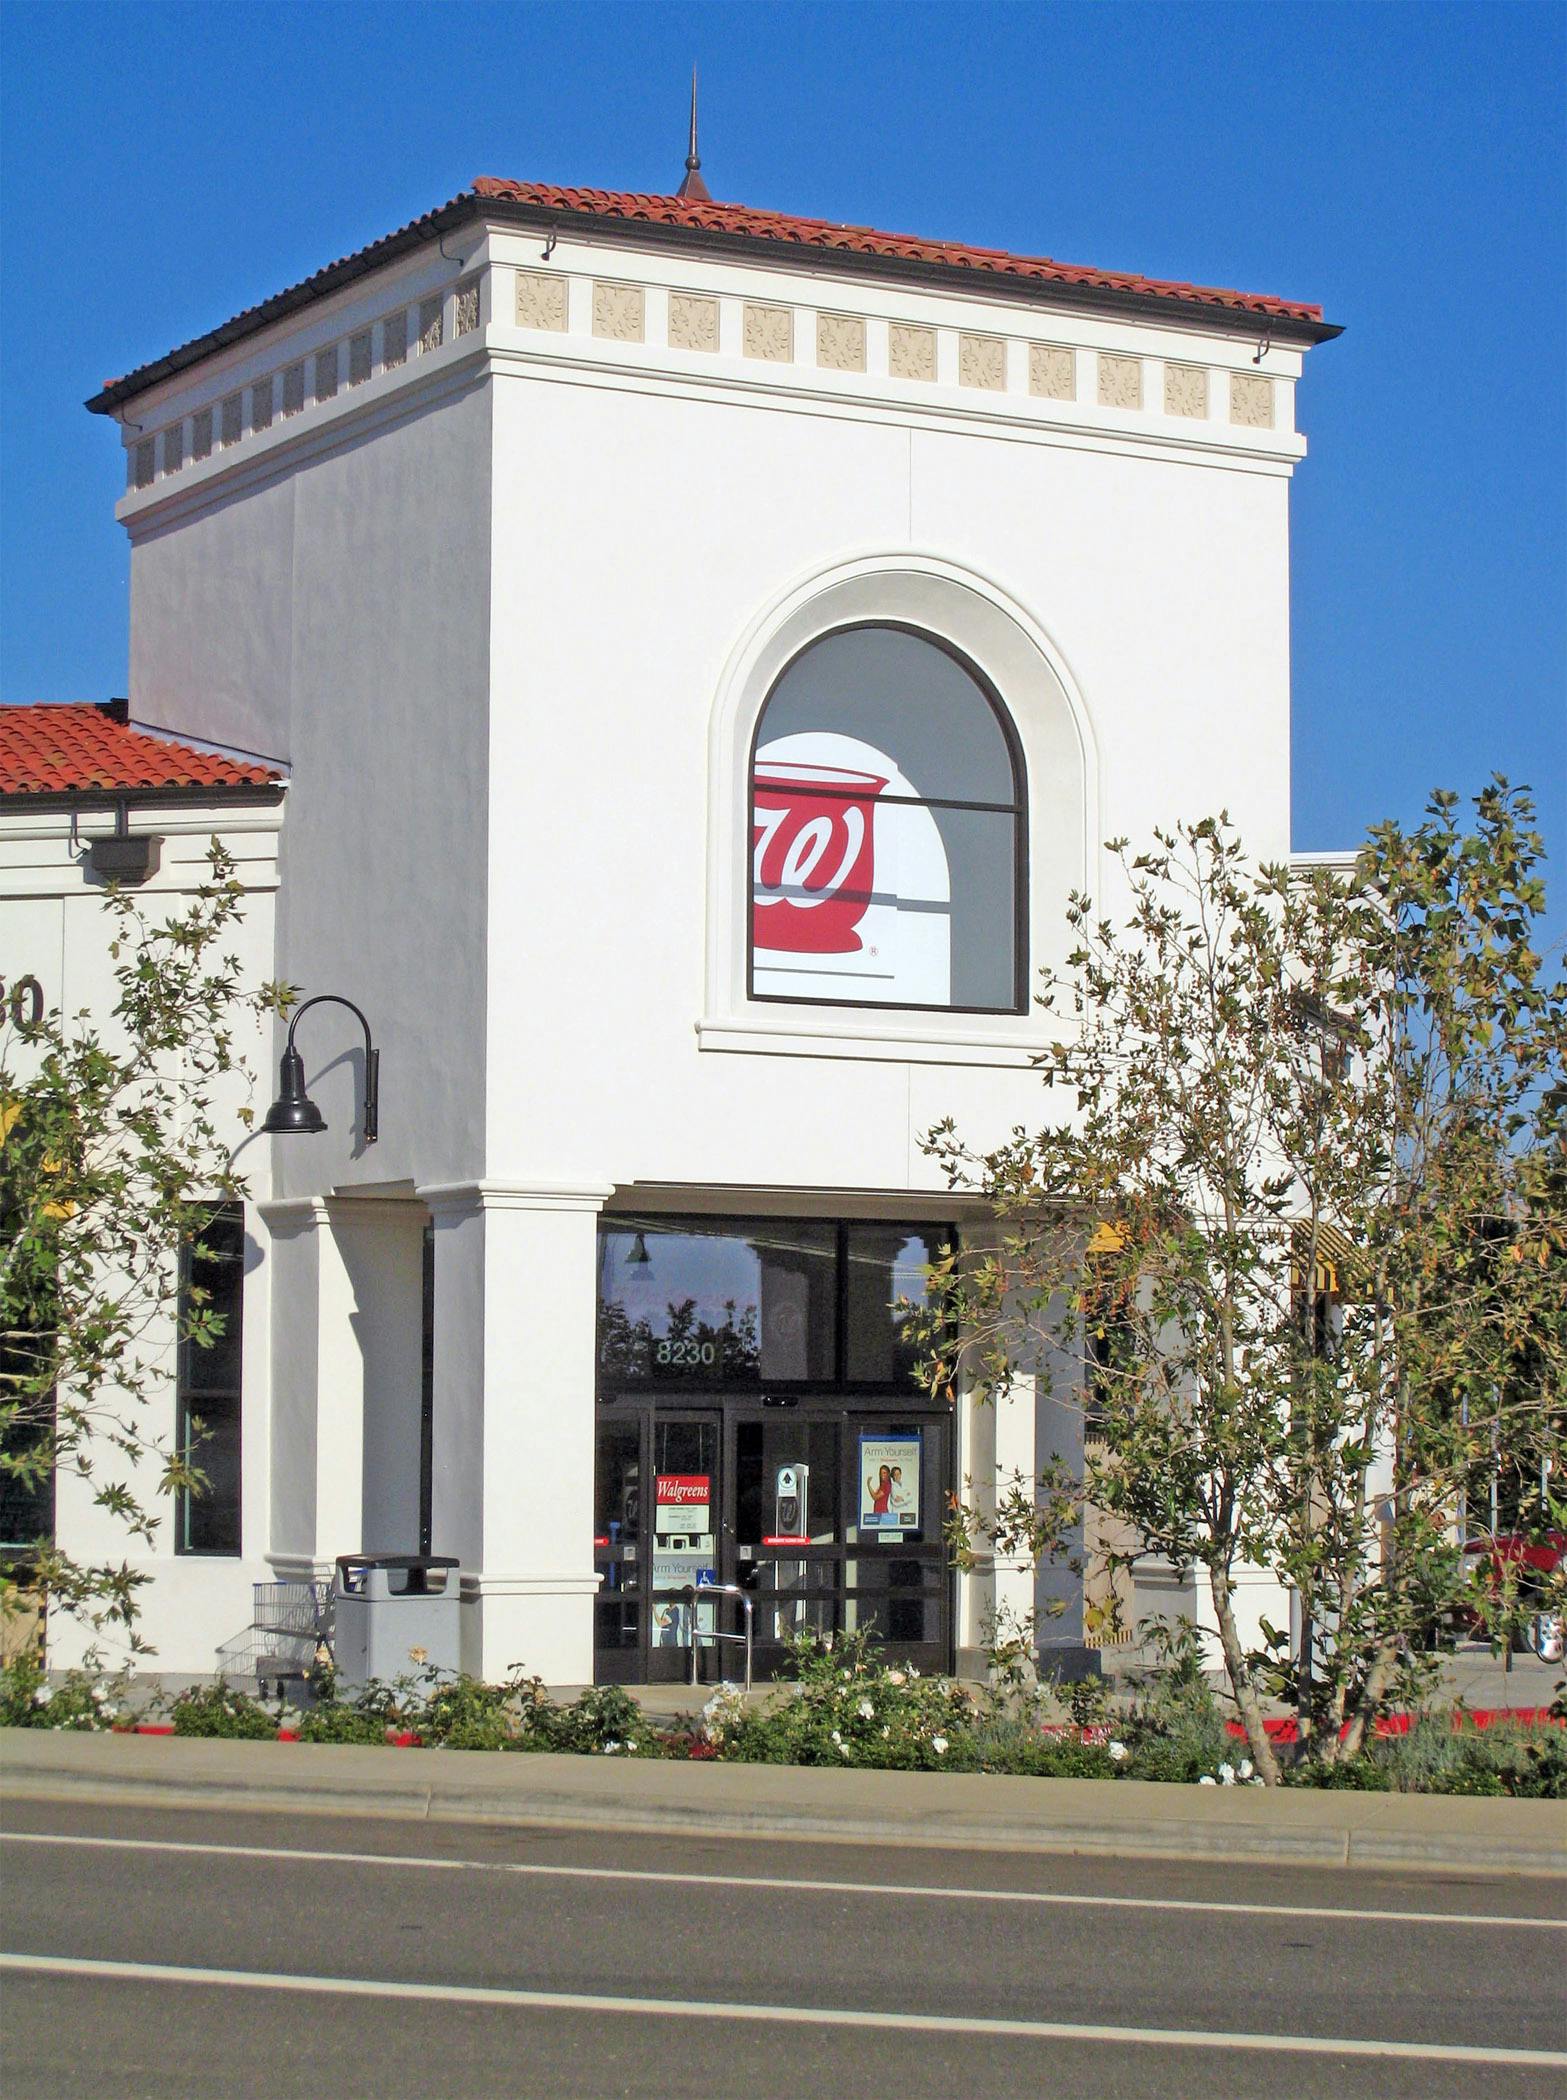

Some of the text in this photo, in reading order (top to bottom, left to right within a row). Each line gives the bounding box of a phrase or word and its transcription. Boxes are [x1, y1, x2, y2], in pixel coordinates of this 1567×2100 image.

[657, 1342, 715, 1365] 8230
[864, 1447, 917, 1458] Arm Yourself
[658, 1480, 709, 1503] Walgreens
